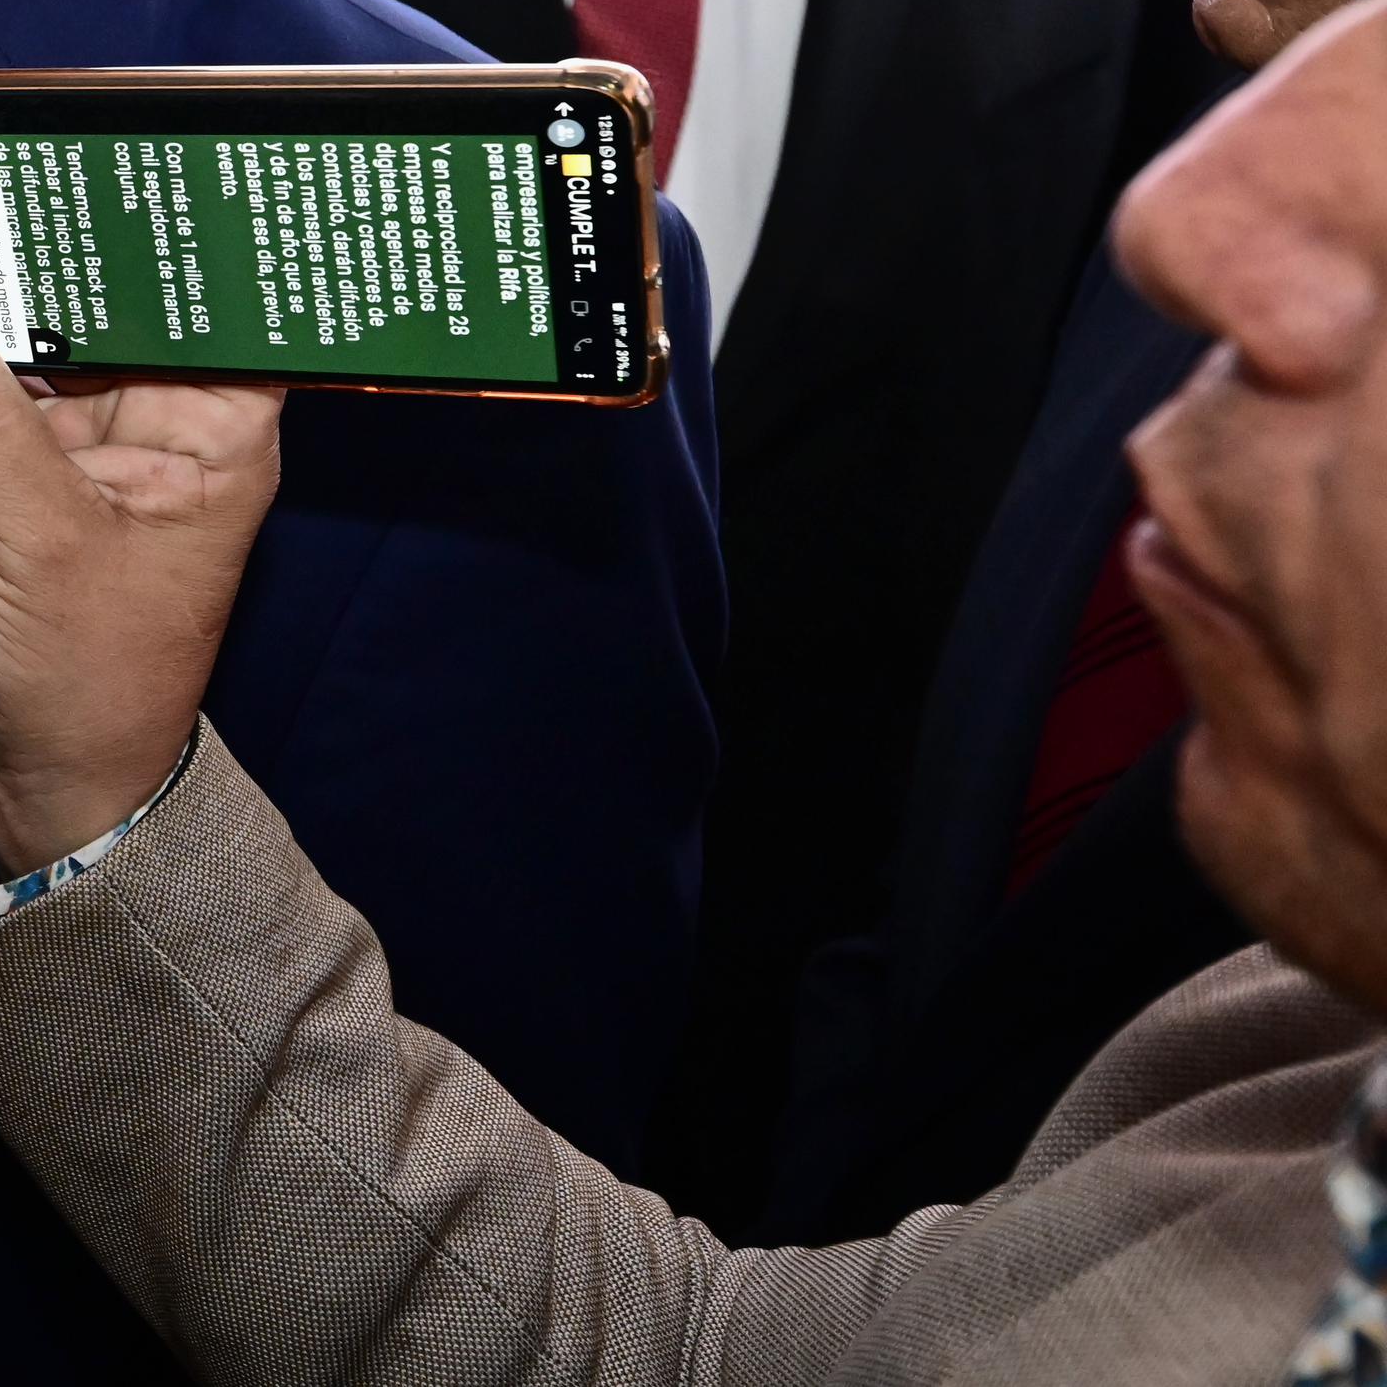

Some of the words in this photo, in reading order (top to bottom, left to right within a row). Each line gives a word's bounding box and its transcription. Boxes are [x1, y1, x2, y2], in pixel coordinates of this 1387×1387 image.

[15, 142, 32, 161] se
[138, 142, 161, 167] mil
[164, 142, 184, 174] Con
[263, 142, 284, 153] y
[293, 142, 311, 153] a
[430, 142, 452, 156] Y
[483, 143, 507, 181] para
[35, 141, 63, 193] grabar
[113, 141, 139, 214] conjunta.
[215, 142, 239, 200] evento.
[237, 142, 269, 213] grabarán
[269, 155, 290, 177] de
[296, 157, 317, 182] los
[347, 142, 373, 207] noticias
[374, 142, 402, 216] digitales,
[431, 158, 450, 180] en
[64, 141, 92, 230] Tendremos
[169, 178, 192, 213] más
[272, 179, 293, 201] fin
[320, 142, 350, 227] contenido,
[402, 142, 427, 225] empresas
[514, 142, 544, 248] empresarios
[19, 164, 49, 241] difundirán
[49, 196, 69, 210] al
[143, 170, 170, 256] seguidores
[276, 204, 296, 225] de
[353, 210, 373, 221] y
[490, 184, 515, 246] realizar
[566, 177, 596, 256] CUMPLE
[52, 213, 75, 254] inicio
[175, 216, 196, 236] de
[252, 217, 270, 246] ese
[299, 185, 326, 263] mensajes
[412, 228, 434, 249] de
[434, 183, 466, 284] reciprocidad
[34, 245, 52, 267] los
[80, 233, 96, 252] un
[179, 240, 198, 248] 1
[279, 228, 301, 258] año
[332, 230, 356, 276] darán
[383, 219, 410, 292] agencias
[496, 249, 518, 264] la
[521, 251, 542, 261] y
[60, 257, 81, 281] del
[84, 256, 107, 294] Back
[157, 260, 177, 280] de
[181, 254, 205, 301] millón
[256, 249, 278, 277] día,
[280, 261, 302, 291] que
[357, 224, 383, 303] creadores
[414, 253, 439, 312] medios
[498, 267, 523, 304] Rifa.
[65, 284, 87, 334] evento
[87, 296, 109, 330] para
[161, 283, 183, 340] manera
[257, 280, 284, 328] previo
[288, 294, 305, 314] se
[310, 266, 337, 345] navideños
[338, 279, 364, 342] difusión
[392, 295, 414, 316] de
[445, 288, 467, 312] las
[522, 264, 550, 337] políticos,
[189, 304, 211, 334] 650
[367, 307, 389, 327] de
[448, 315, 470, 336] 28
[70, 336, 88, 346] y
[268, 331, 289, 345] al
